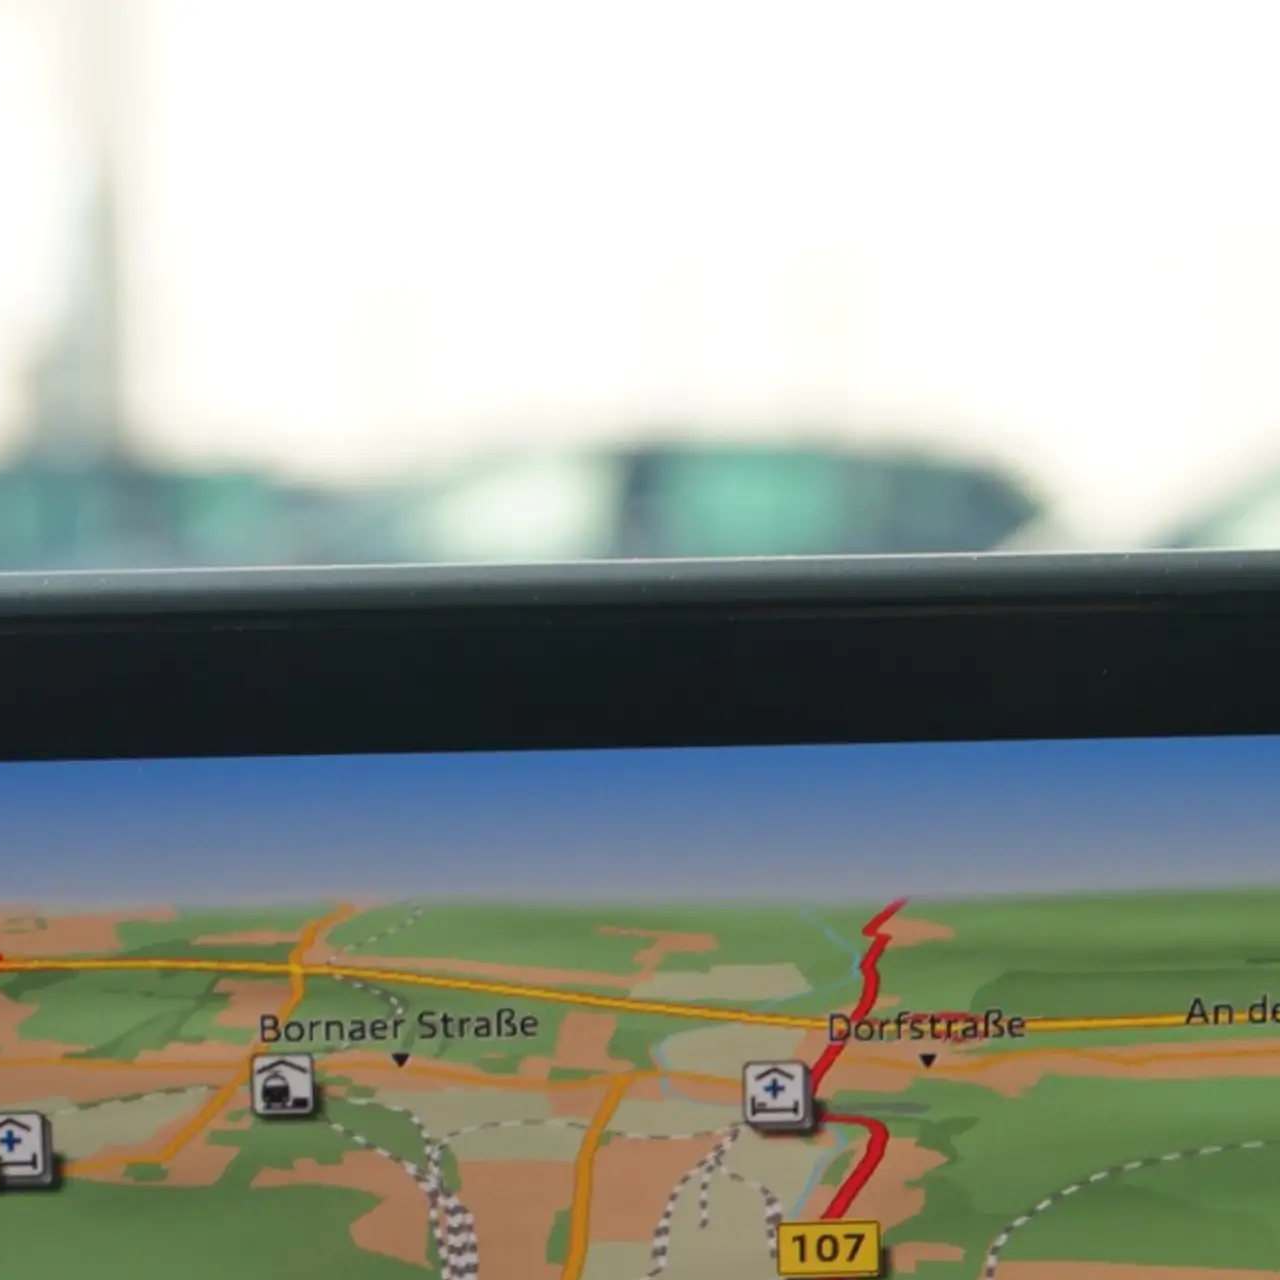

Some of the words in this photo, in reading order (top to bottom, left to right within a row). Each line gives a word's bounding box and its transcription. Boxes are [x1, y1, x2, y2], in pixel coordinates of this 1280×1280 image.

[259, 1014, 405, 1044] Bornaer
[418, 1008, 540, 1039] Straße
[828, 1011, 1026, 1042] Dorfstraße
[1185, 998, 1234, 1025] An
[791, 1233, 865, 1264] 107
